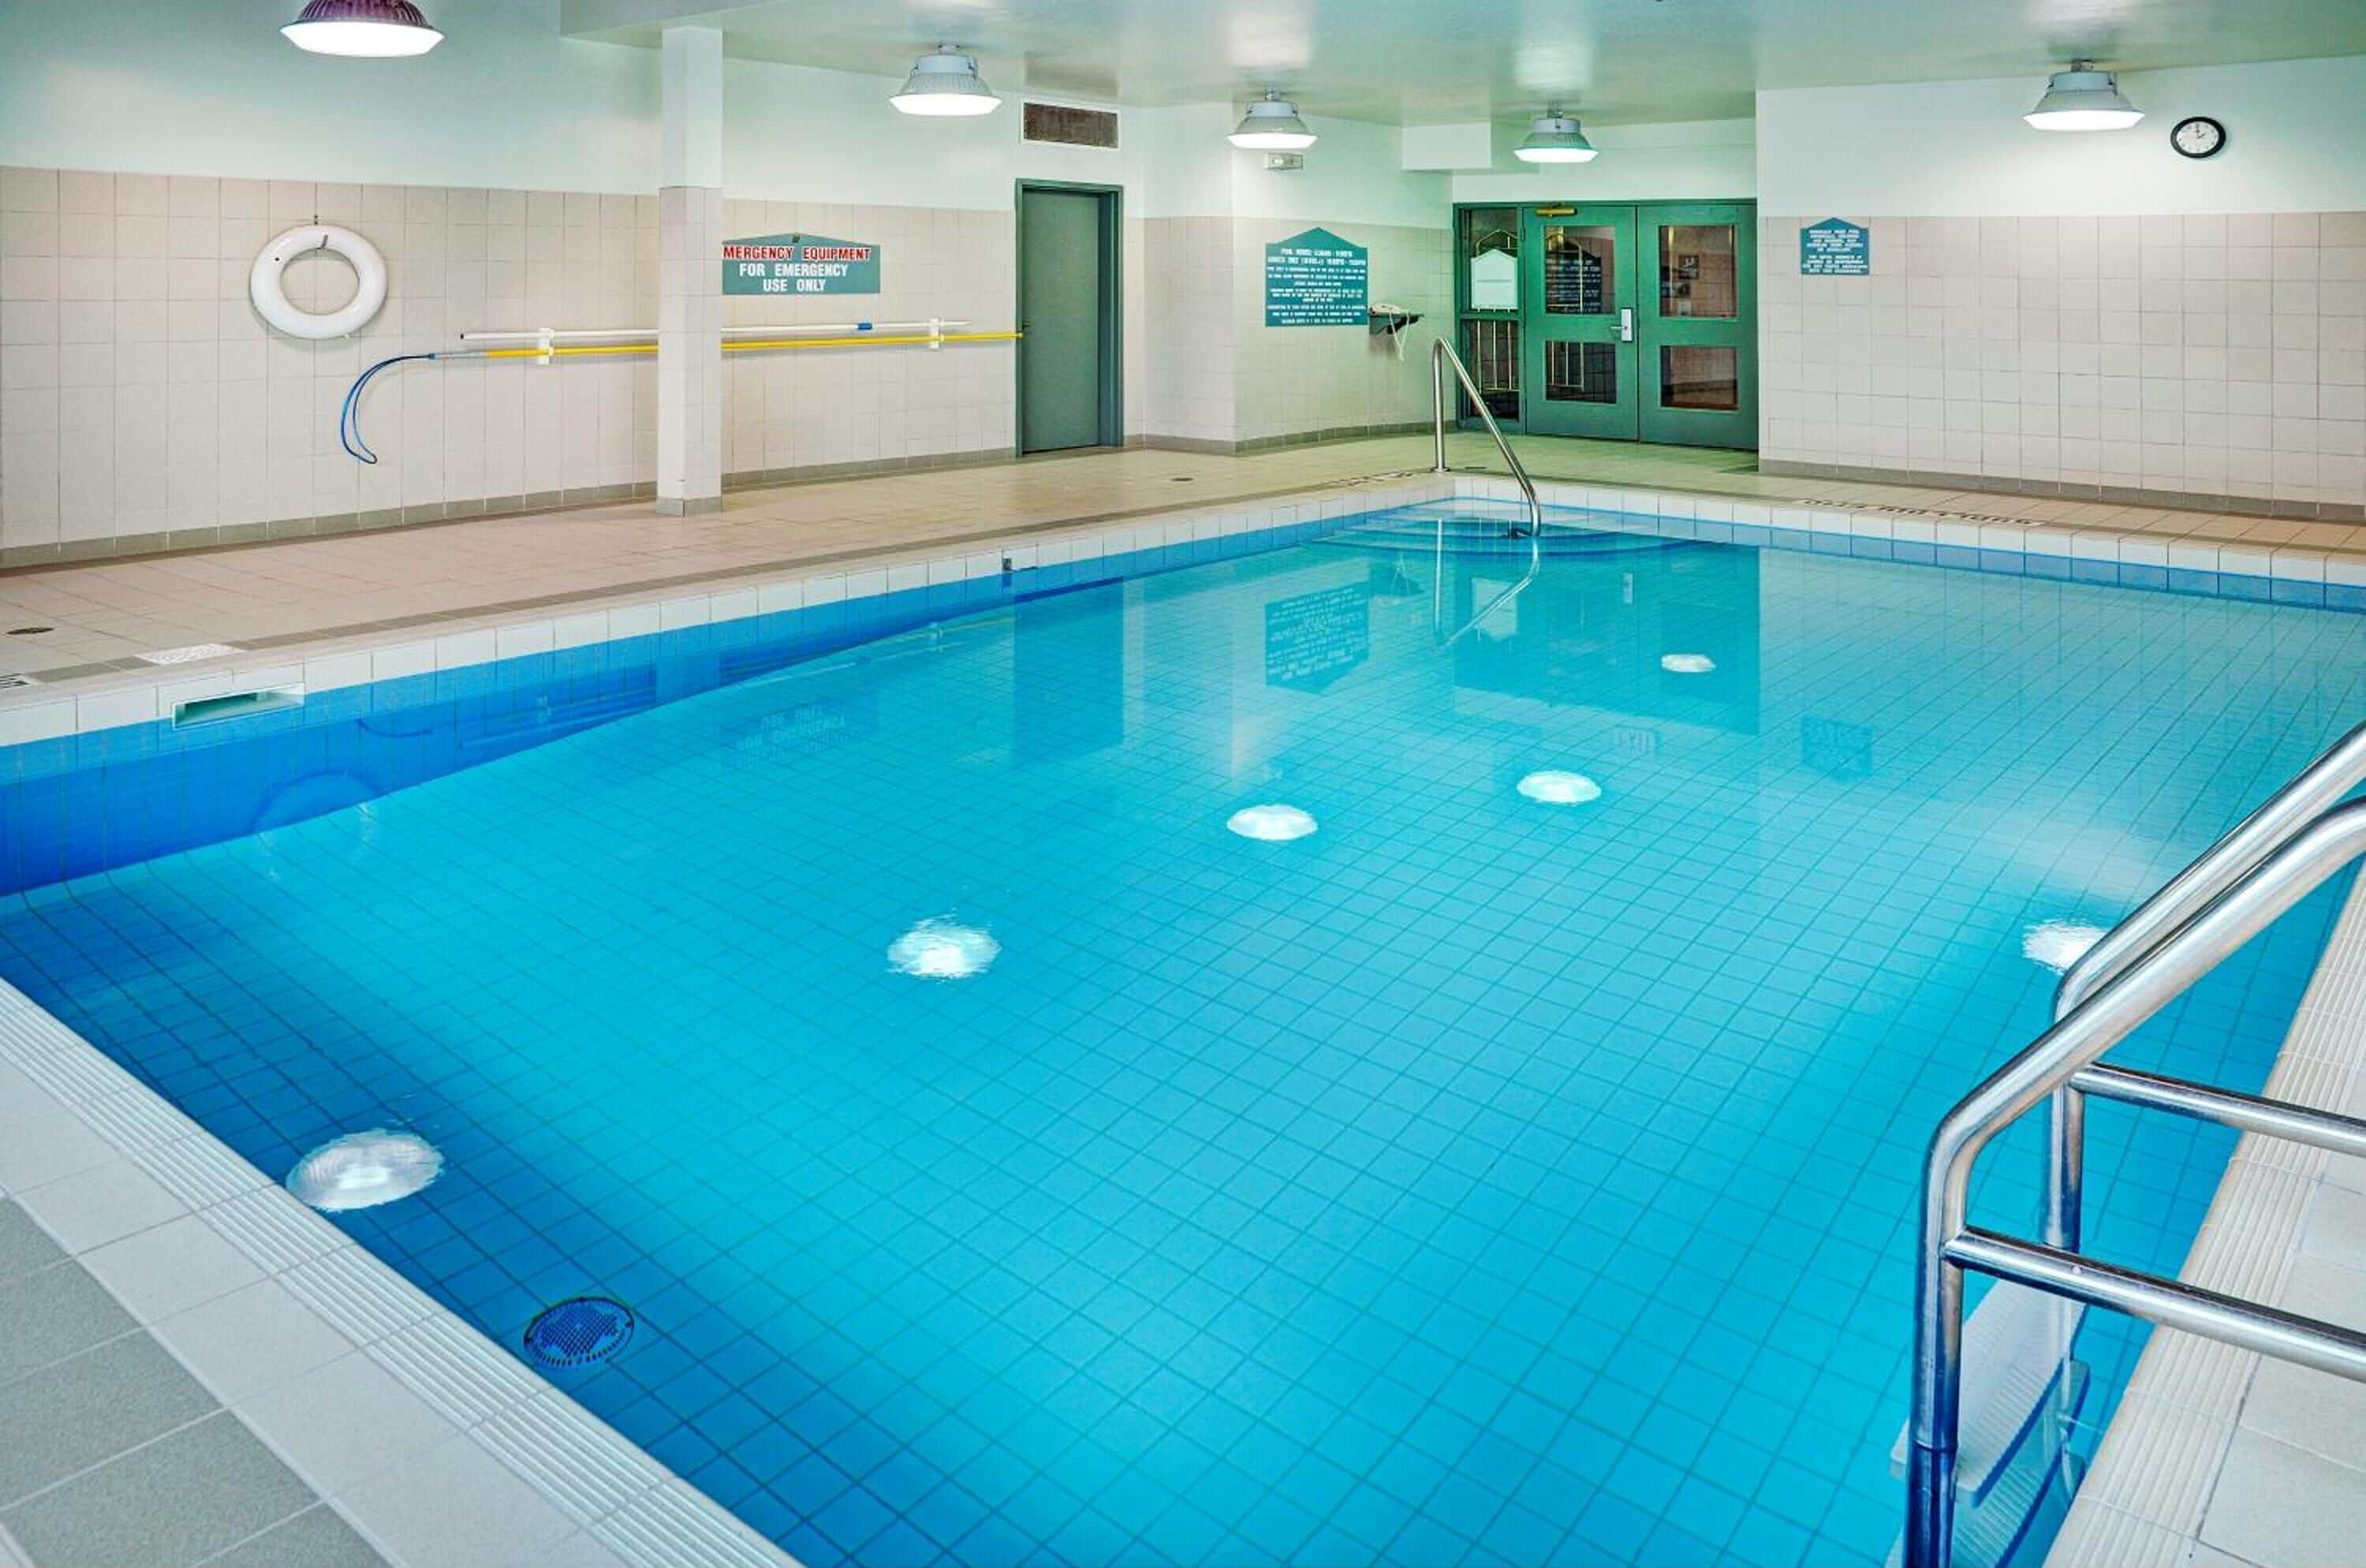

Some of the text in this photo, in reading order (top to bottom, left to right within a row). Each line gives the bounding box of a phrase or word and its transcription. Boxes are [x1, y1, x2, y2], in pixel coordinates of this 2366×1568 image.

[722, 246, 871, 261] MERGENCY EQUIPMENT
[739, 263, 849, 277] FOR EMERGENCY
[763, 278, 826, 292] USE ONLY
